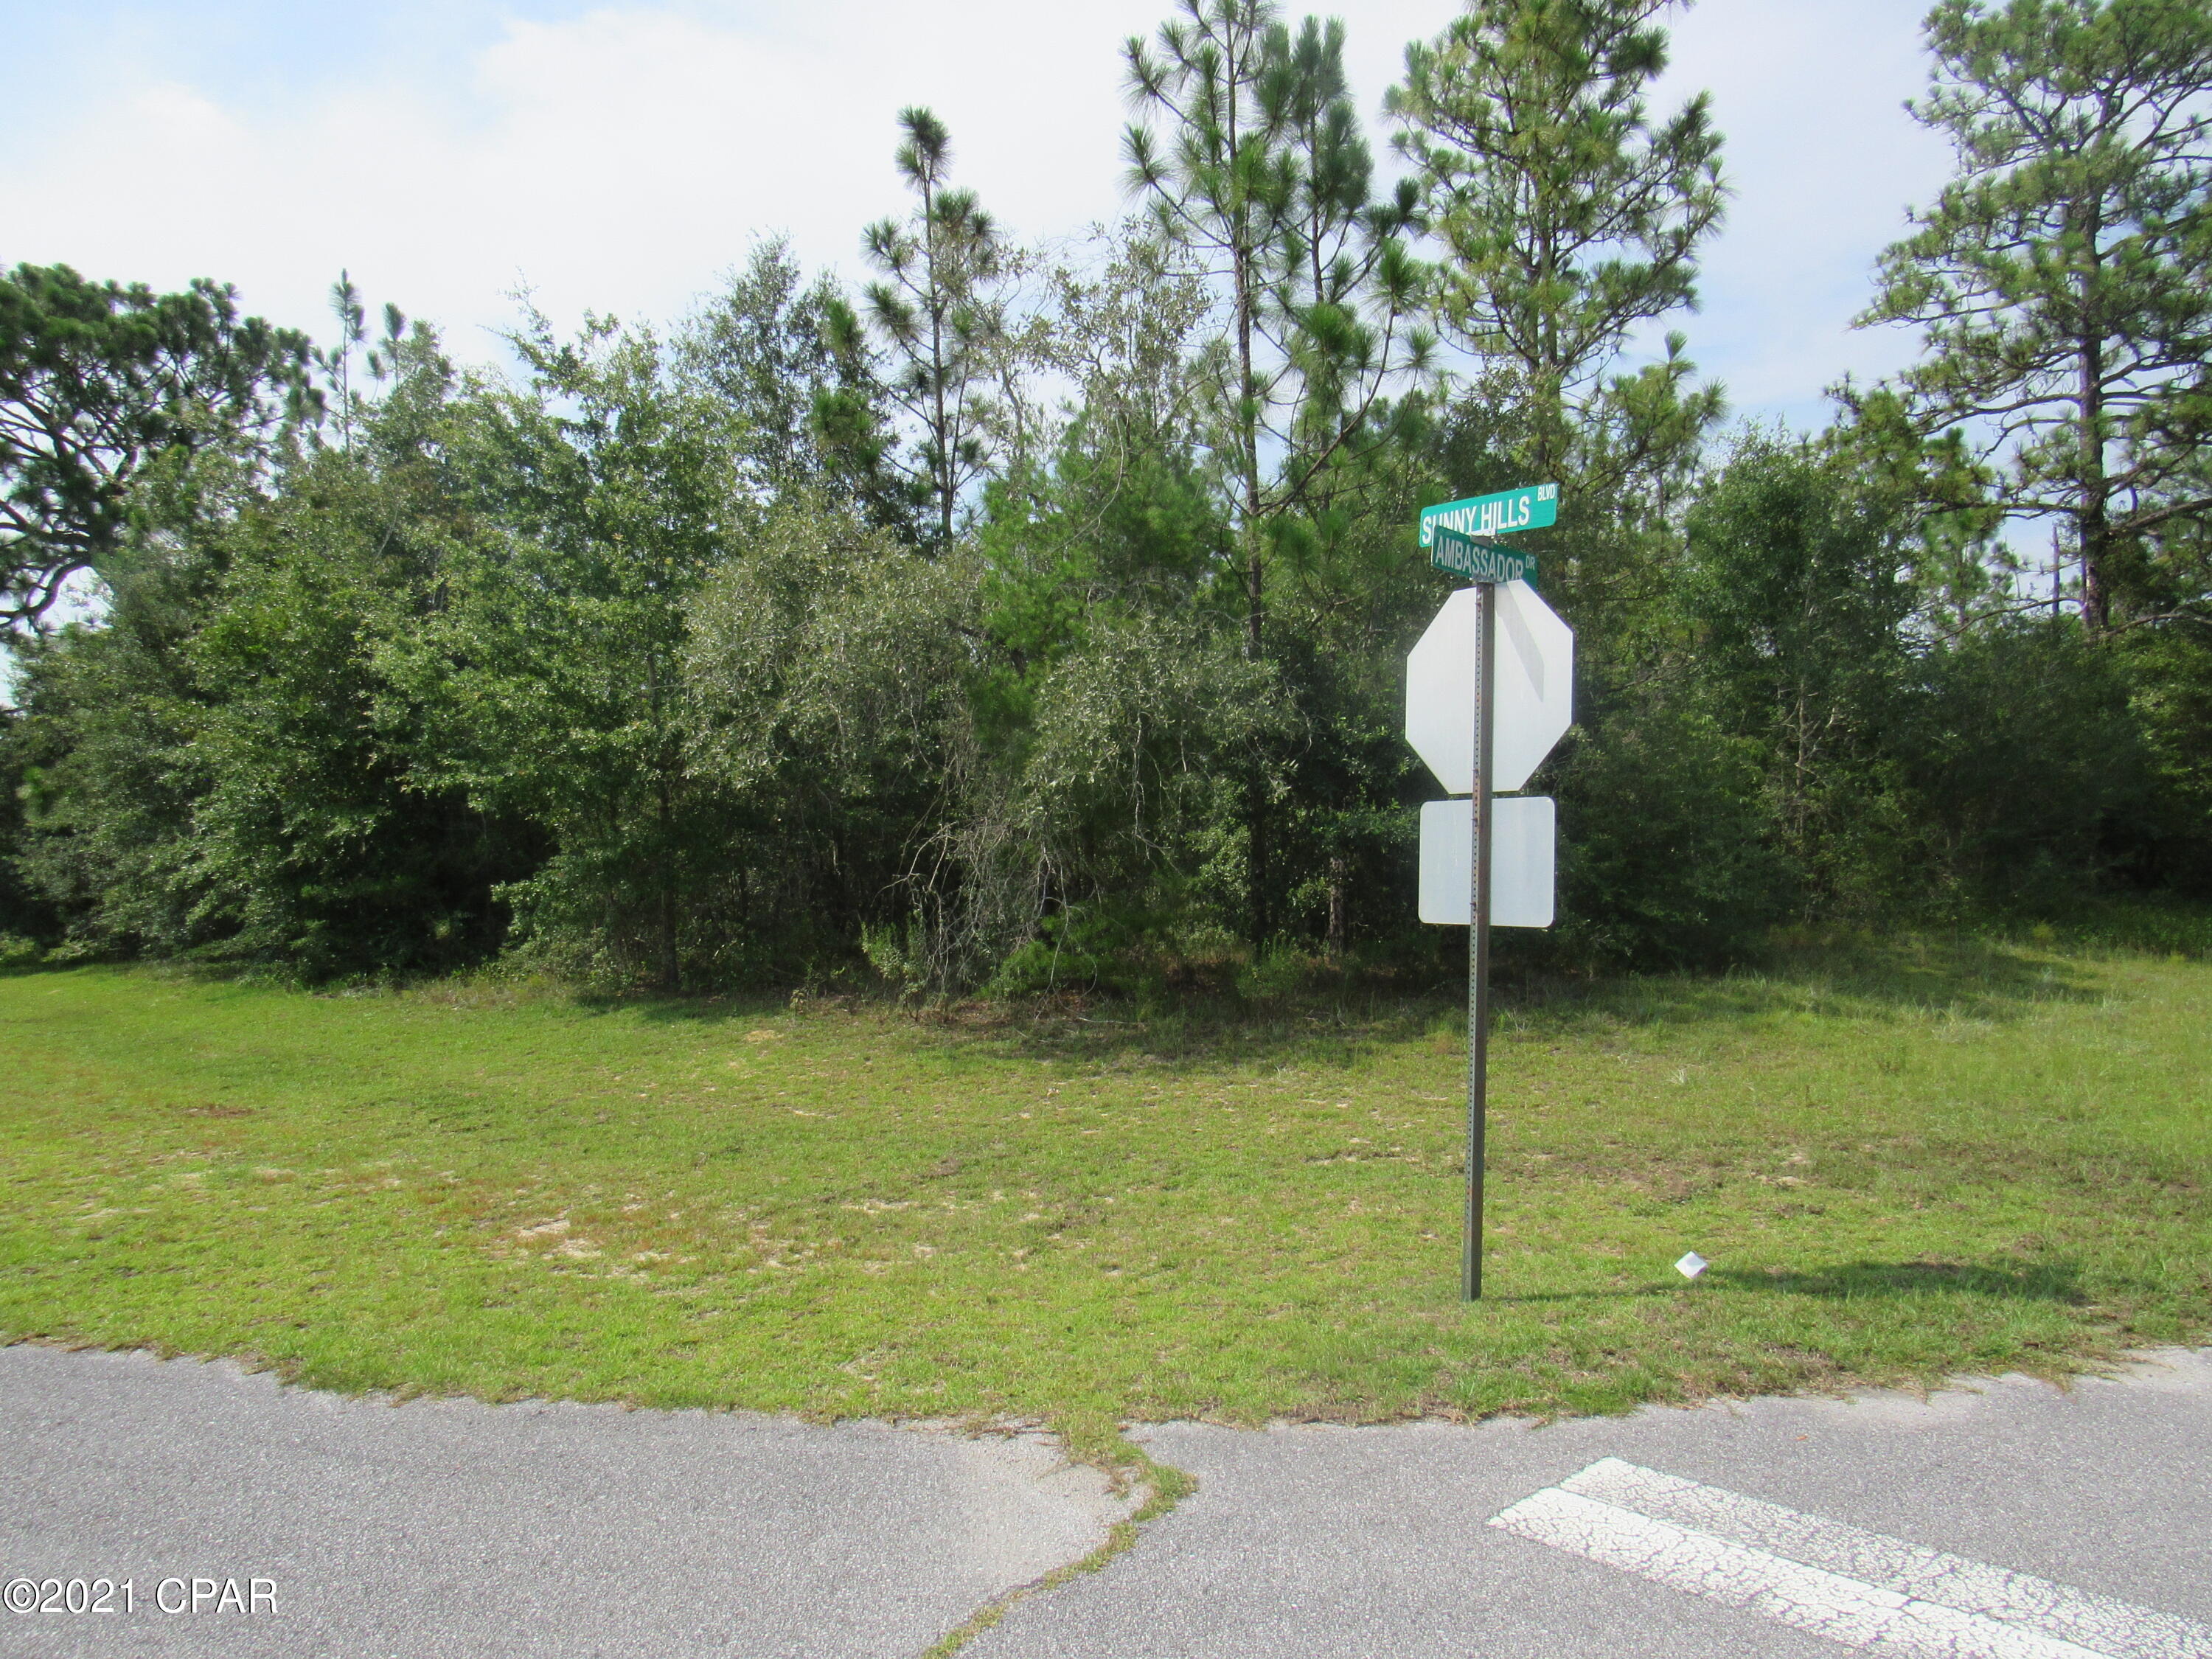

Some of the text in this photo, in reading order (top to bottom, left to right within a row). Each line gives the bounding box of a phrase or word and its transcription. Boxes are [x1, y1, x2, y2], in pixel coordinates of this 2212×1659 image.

[1481, 495, 1530, 530] HILLS
[1537, 484, 1556, 501] BLVD
[1436, 535, 1536, 581] AMBASSADOR DR
